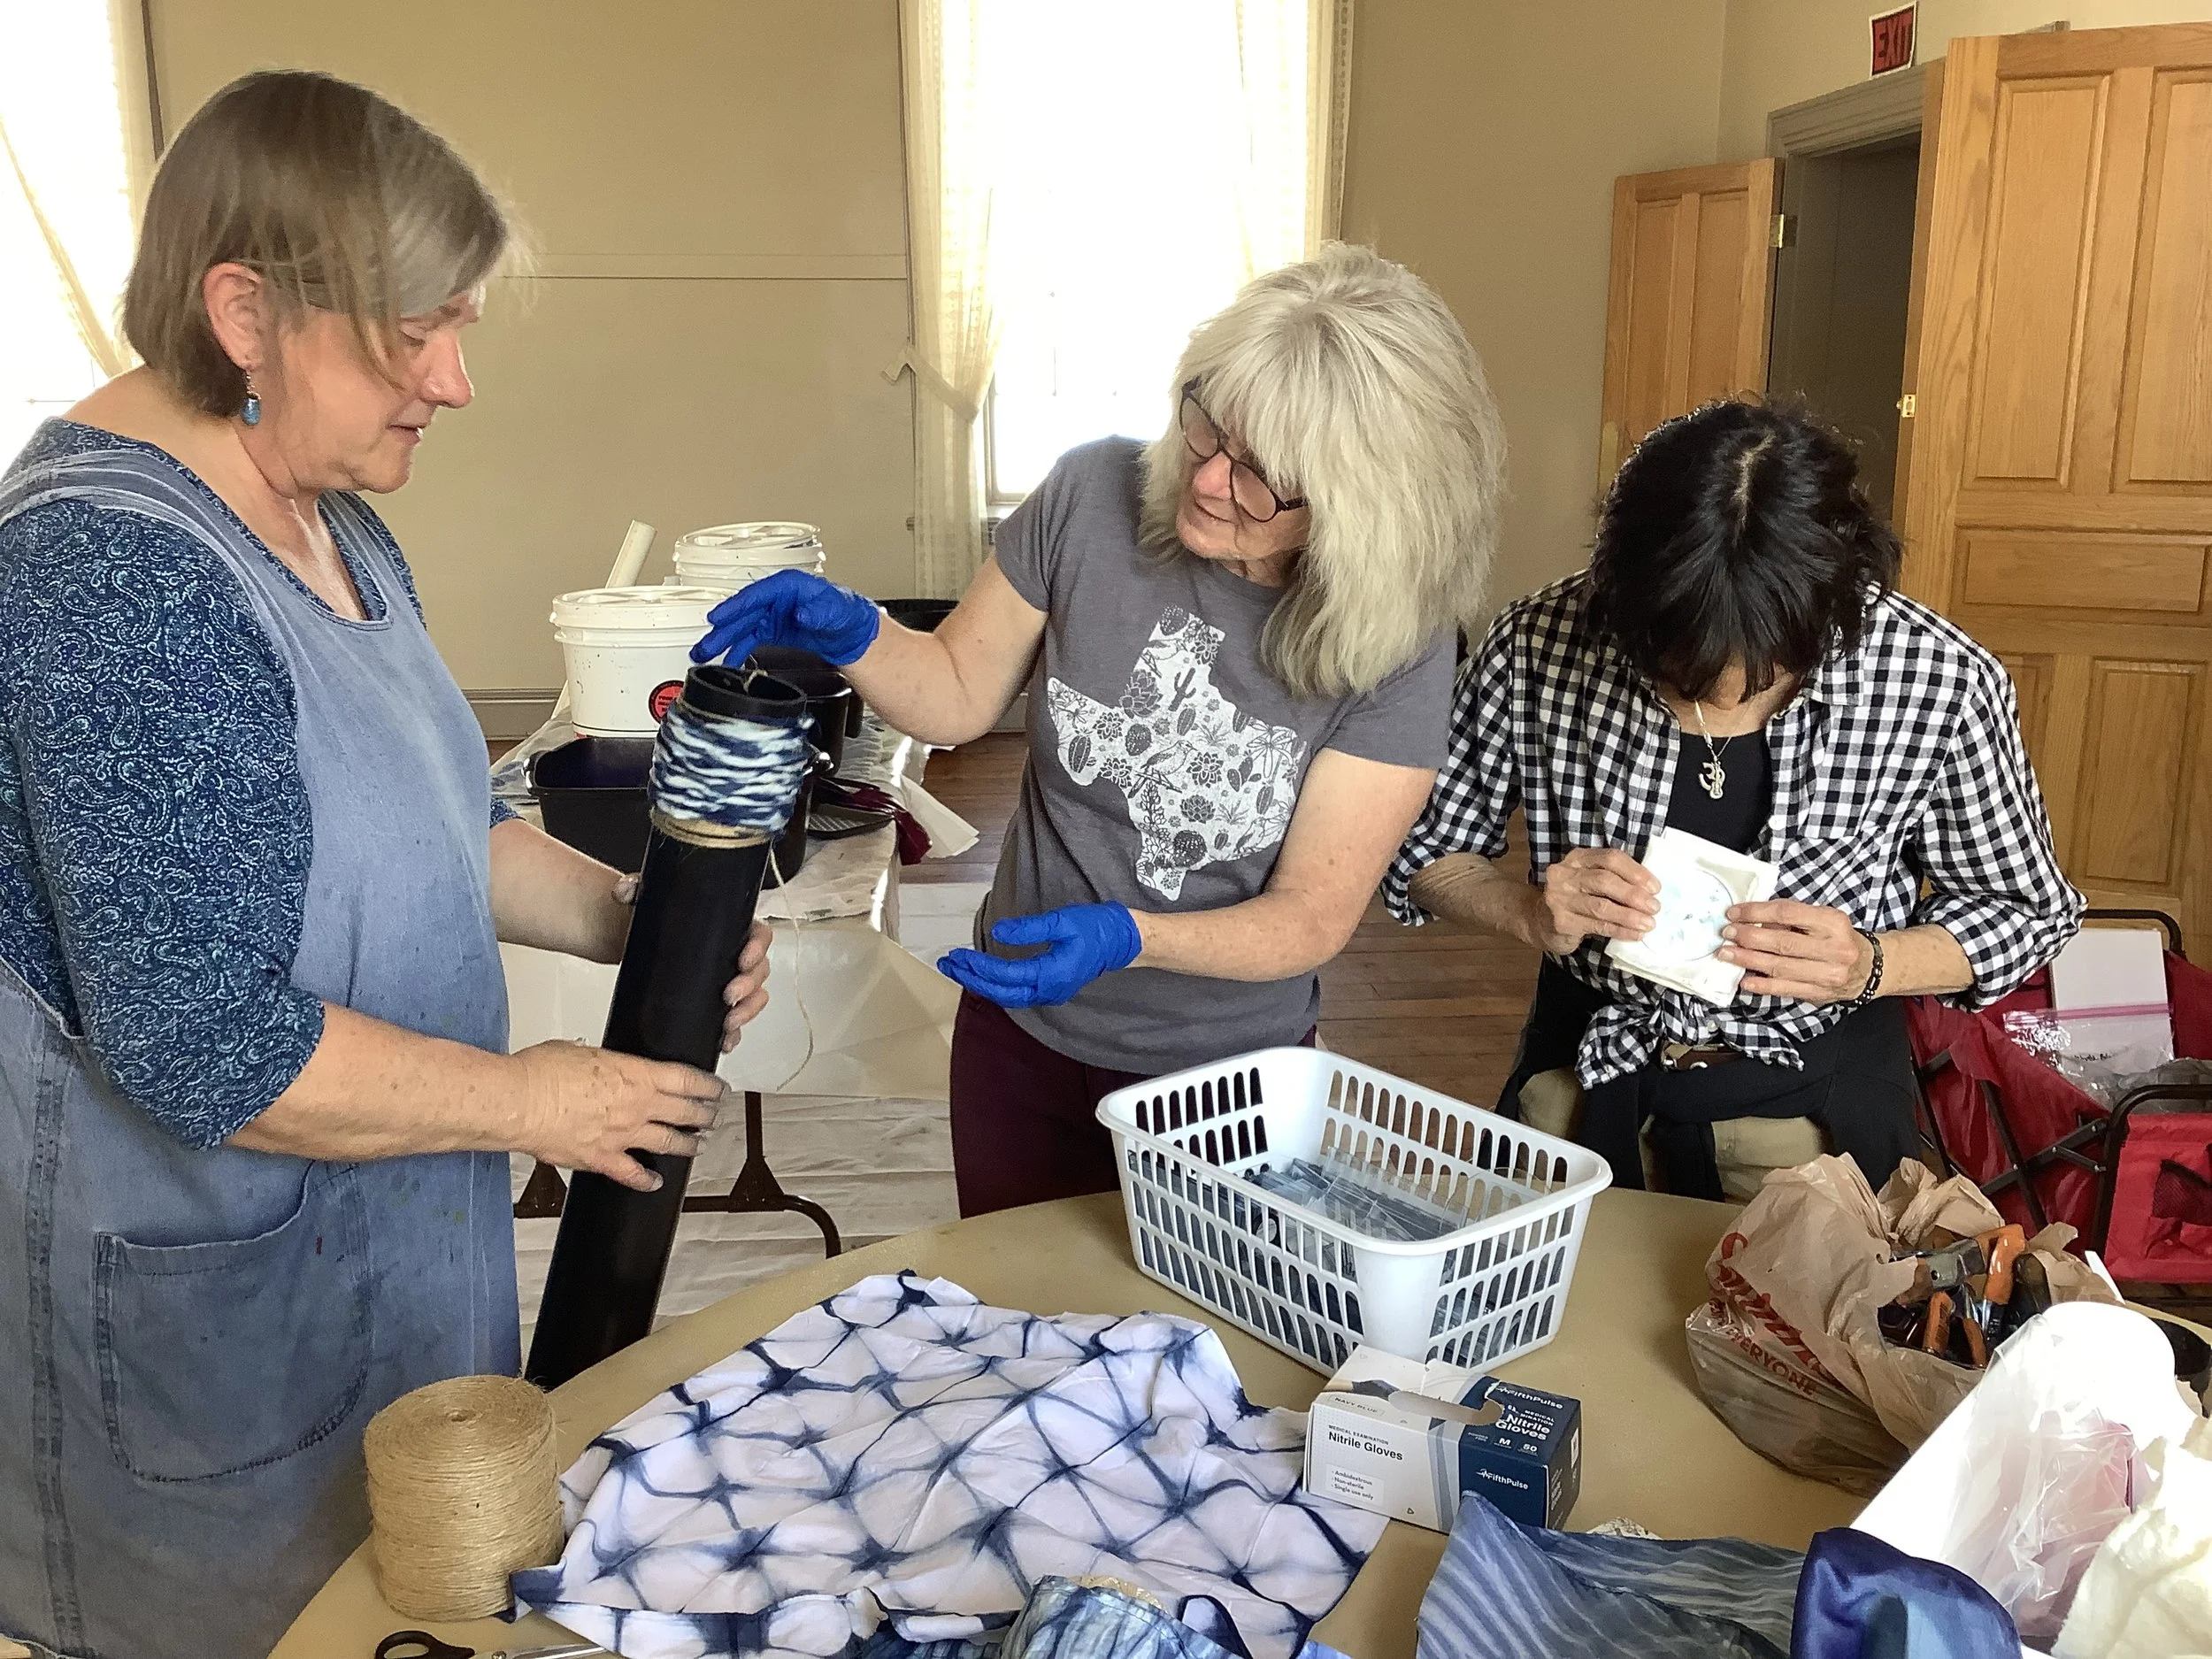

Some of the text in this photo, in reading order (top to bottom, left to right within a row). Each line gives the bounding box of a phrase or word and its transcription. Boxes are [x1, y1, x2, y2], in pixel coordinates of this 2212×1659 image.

[1334, 1397, 1355, 1406] NAVY
[1509, 1389, 1563, 1409] FifthPulse
[1506, 1413, 1550, 1434] Nitrile
[1525, 1409, 1555, 1423] MEDICAL
[1328, 1425, 1389, 1445] MEDICAL EXAMINATION
[1494, 1420, 1547, 1440] Gloves
[1329, 1431, 1403, 1461] Nitrile Gloves
[1334, 1471, 1372, 1486] Ambidextrous
[1334, 1483, 1350, 1493] Single
[1487, 1472, 1529, 1490] FifthPulse
